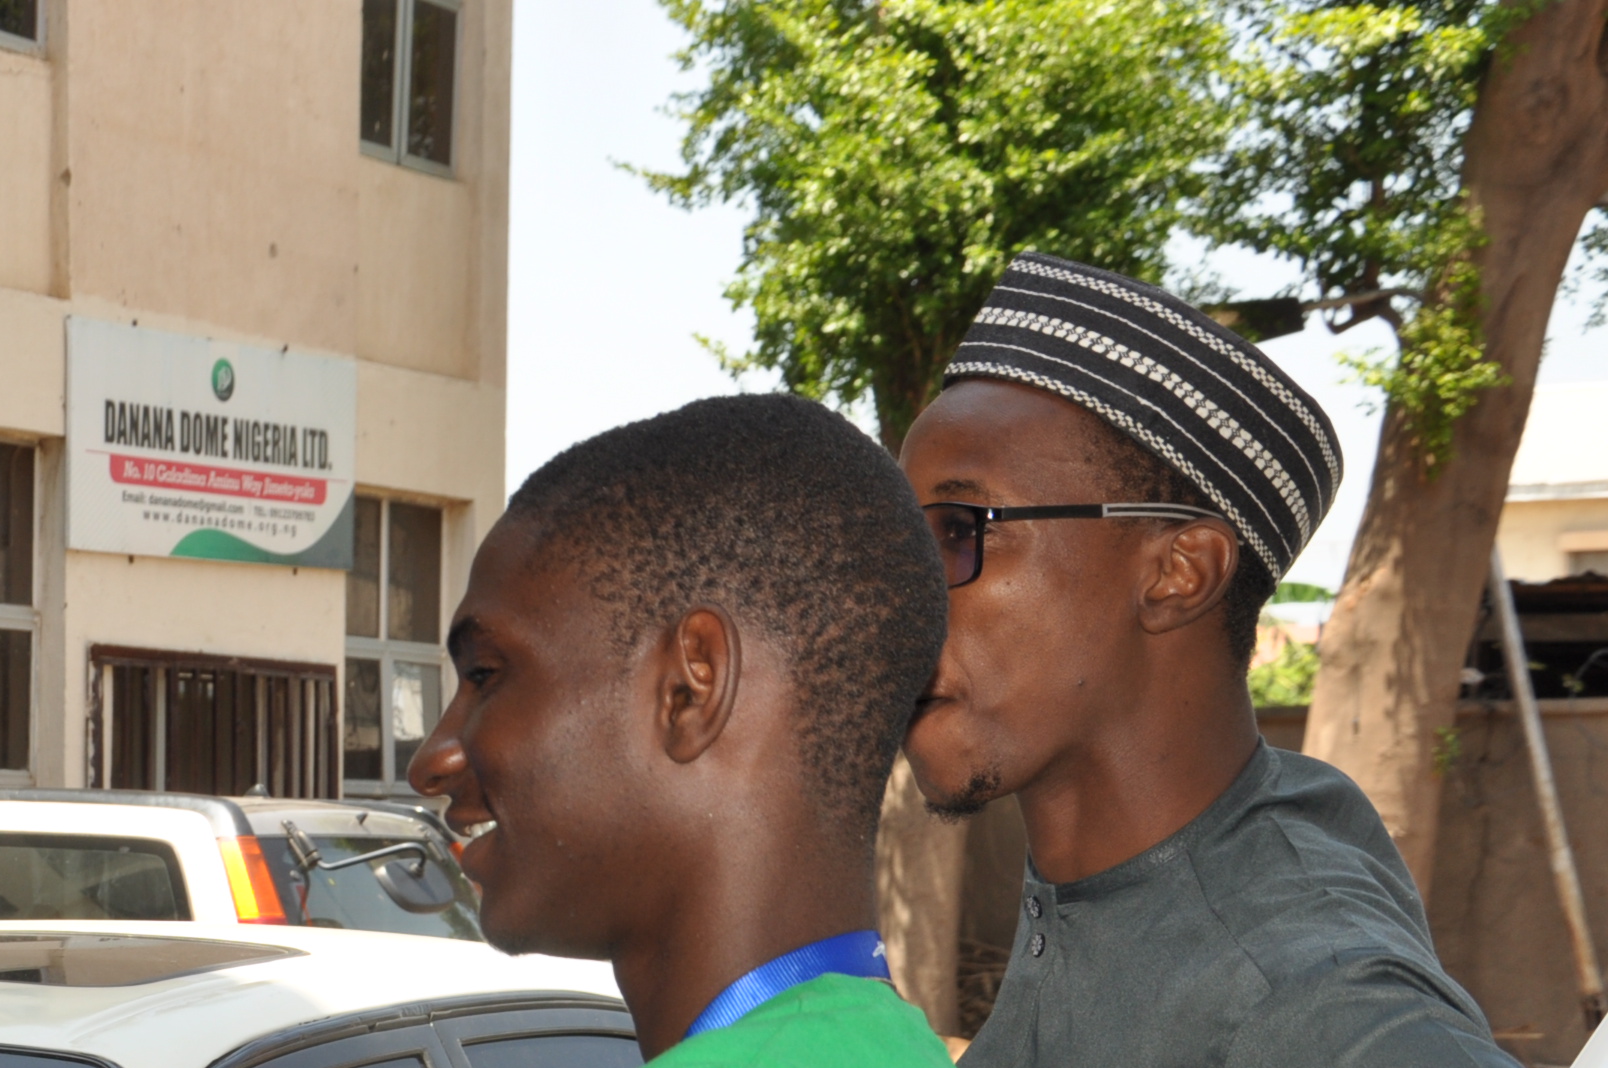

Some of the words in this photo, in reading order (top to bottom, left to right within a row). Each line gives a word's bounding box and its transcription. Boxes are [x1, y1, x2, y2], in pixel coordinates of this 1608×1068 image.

[104, 399, 175, 452] DANANA
[180, 410, 228, 459] DOME
[233, 418, 298, 467] NIGERIA
[143, 463, 156, 481] 10
[240, 474, 263, 498] Way
